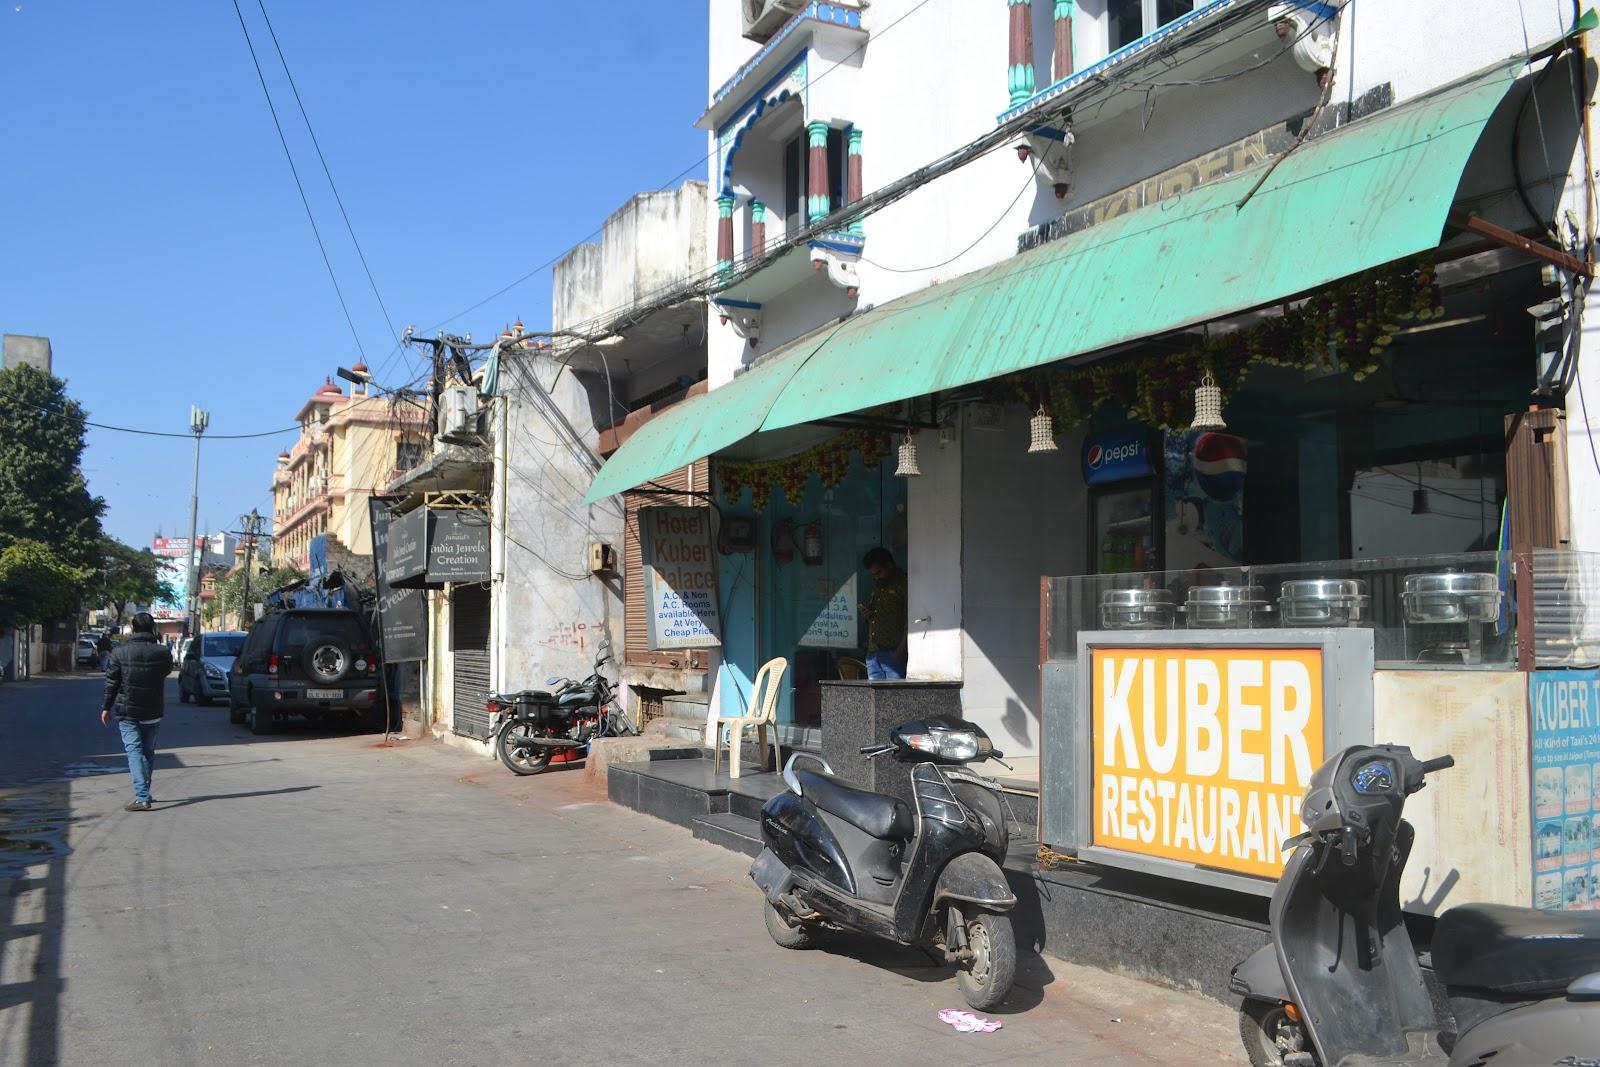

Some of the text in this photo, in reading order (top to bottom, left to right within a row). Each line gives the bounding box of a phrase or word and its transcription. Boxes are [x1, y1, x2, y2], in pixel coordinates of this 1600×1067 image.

[1105, 440, 1138, 465] pepsi
[656, 511, 705, 535] Hotel
[455, 540, 485, 554] Jewels
[655, 538, 709, 562] Kuber
[437, 554, 478, 565] Creation
[655, 566, 716, 591] Palace
[683, 592, 689, 600] &
[691, 591, 708, 600] Non
[682, 600, 711, 609] Rooms
[658, 609, 716, 619] available Here
[673, 619, 704, 628] At Very
[664, 627, 714, 637] Cheap Price
[1535, 681, 1591, 731] KUBER
[1103, 658, 1312, 786] KUBER
[765, 818, 788, 835] Activa
